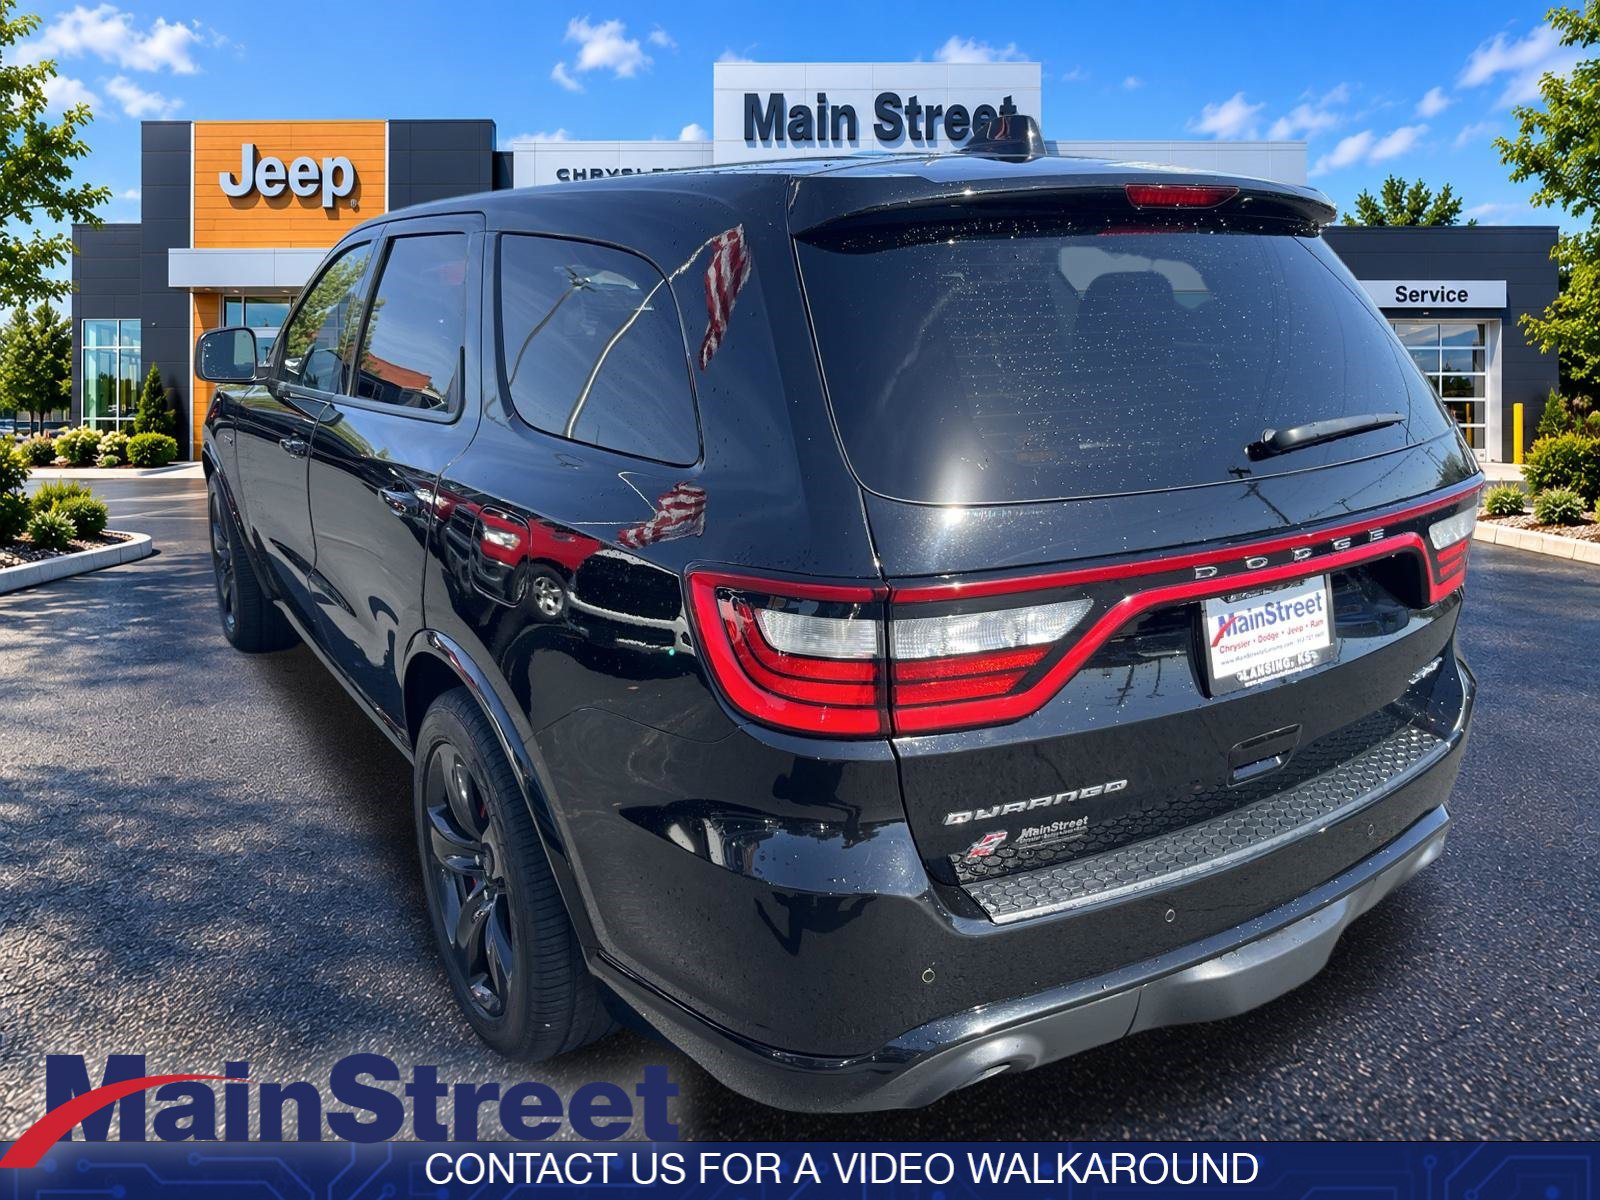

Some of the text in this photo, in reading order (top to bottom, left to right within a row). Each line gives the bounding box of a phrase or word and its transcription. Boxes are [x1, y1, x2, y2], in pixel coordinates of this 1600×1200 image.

[744, 92, 857, 142] Main
[218, 143, 355, 208] Jeep
[1395, 285, 1469, 303] Service
[1194, 528, 1385, 580] DODGE
[1216, 591, 1323, 638] MainStreet
[1219, 619, 1324, 655] Chrysler Dodge Jeep Ram
[1297, 650, 1313, 665] KS
[942, 779, 1128, 826] DURANGO
[1018, 815, 1089, 839] MainStreet
